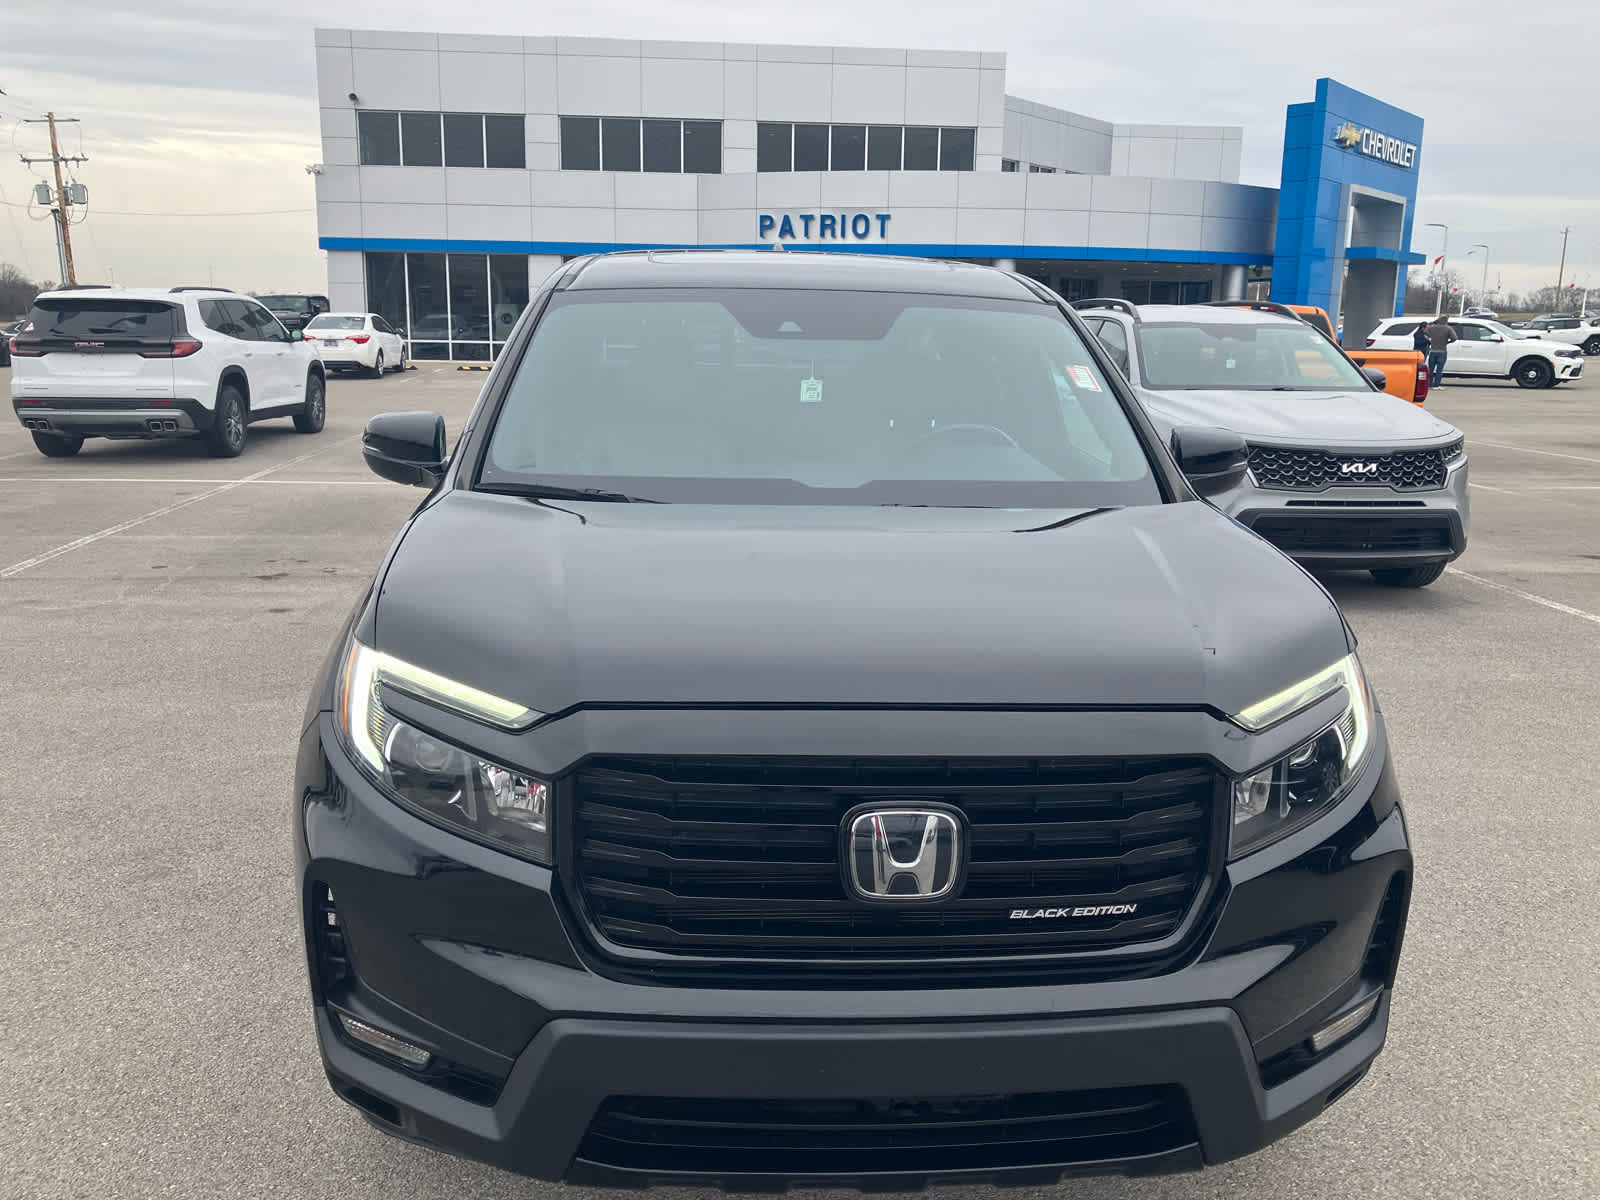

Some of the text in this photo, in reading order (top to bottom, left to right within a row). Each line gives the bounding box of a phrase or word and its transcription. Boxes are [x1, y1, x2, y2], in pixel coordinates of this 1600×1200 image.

[1362, 127, 1417, 168] CHEVROLET
[759, 213, 892, 240] PATRIOT
[1342, 462, 1378, 473] KIA
[1010, 903, 1138, 920] BLACK EDITION
